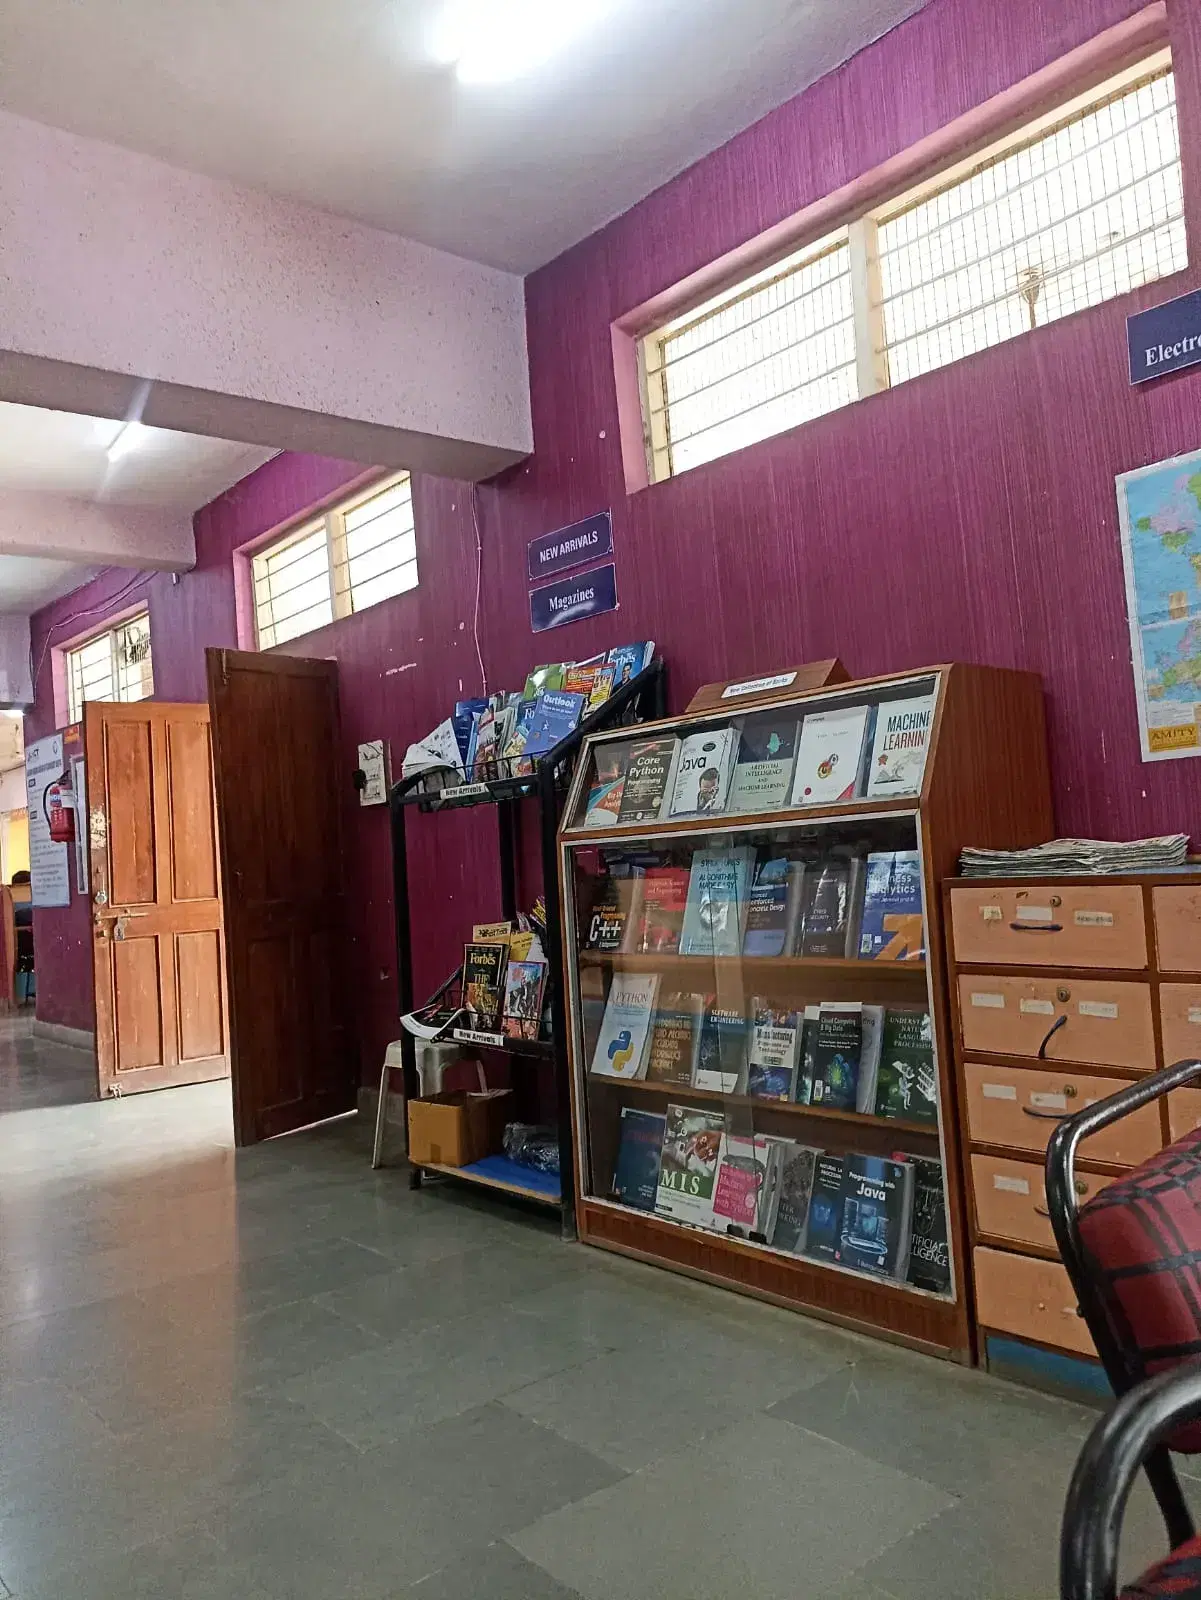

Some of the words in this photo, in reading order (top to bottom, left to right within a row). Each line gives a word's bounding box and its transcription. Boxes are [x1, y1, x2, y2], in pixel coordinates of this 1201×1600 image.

[539, 548, 558, 564] NEW
[559, 530, 598, 556] ARRIVALS
[549, 587, 594, 612] Magazines
[544, 694, 576, 707] Outlook
[883, 730, 928, 751] LEARNIN
[637, 757, 661, 767] Core
[680, 756, 707, 773] Java
[629, 766, 665, 779] Python
[589, 914, 622, 942] C++
[470, 952, 496, 965] Forbes
[616, 991, 648, 1003] PYTHON
[710, 1016, 745, 1025] ENGINEERING
[711, 1008, 739, 1018] SOFTWARE
[459, 1030, 472, 1040] New
[471, 1033, 497, 1044] Arrivals
[660, 1168, 700, 1195] MIS
[848, 1171, 885, 1188] Programming
[856, 1182, 886, 1201] Java
